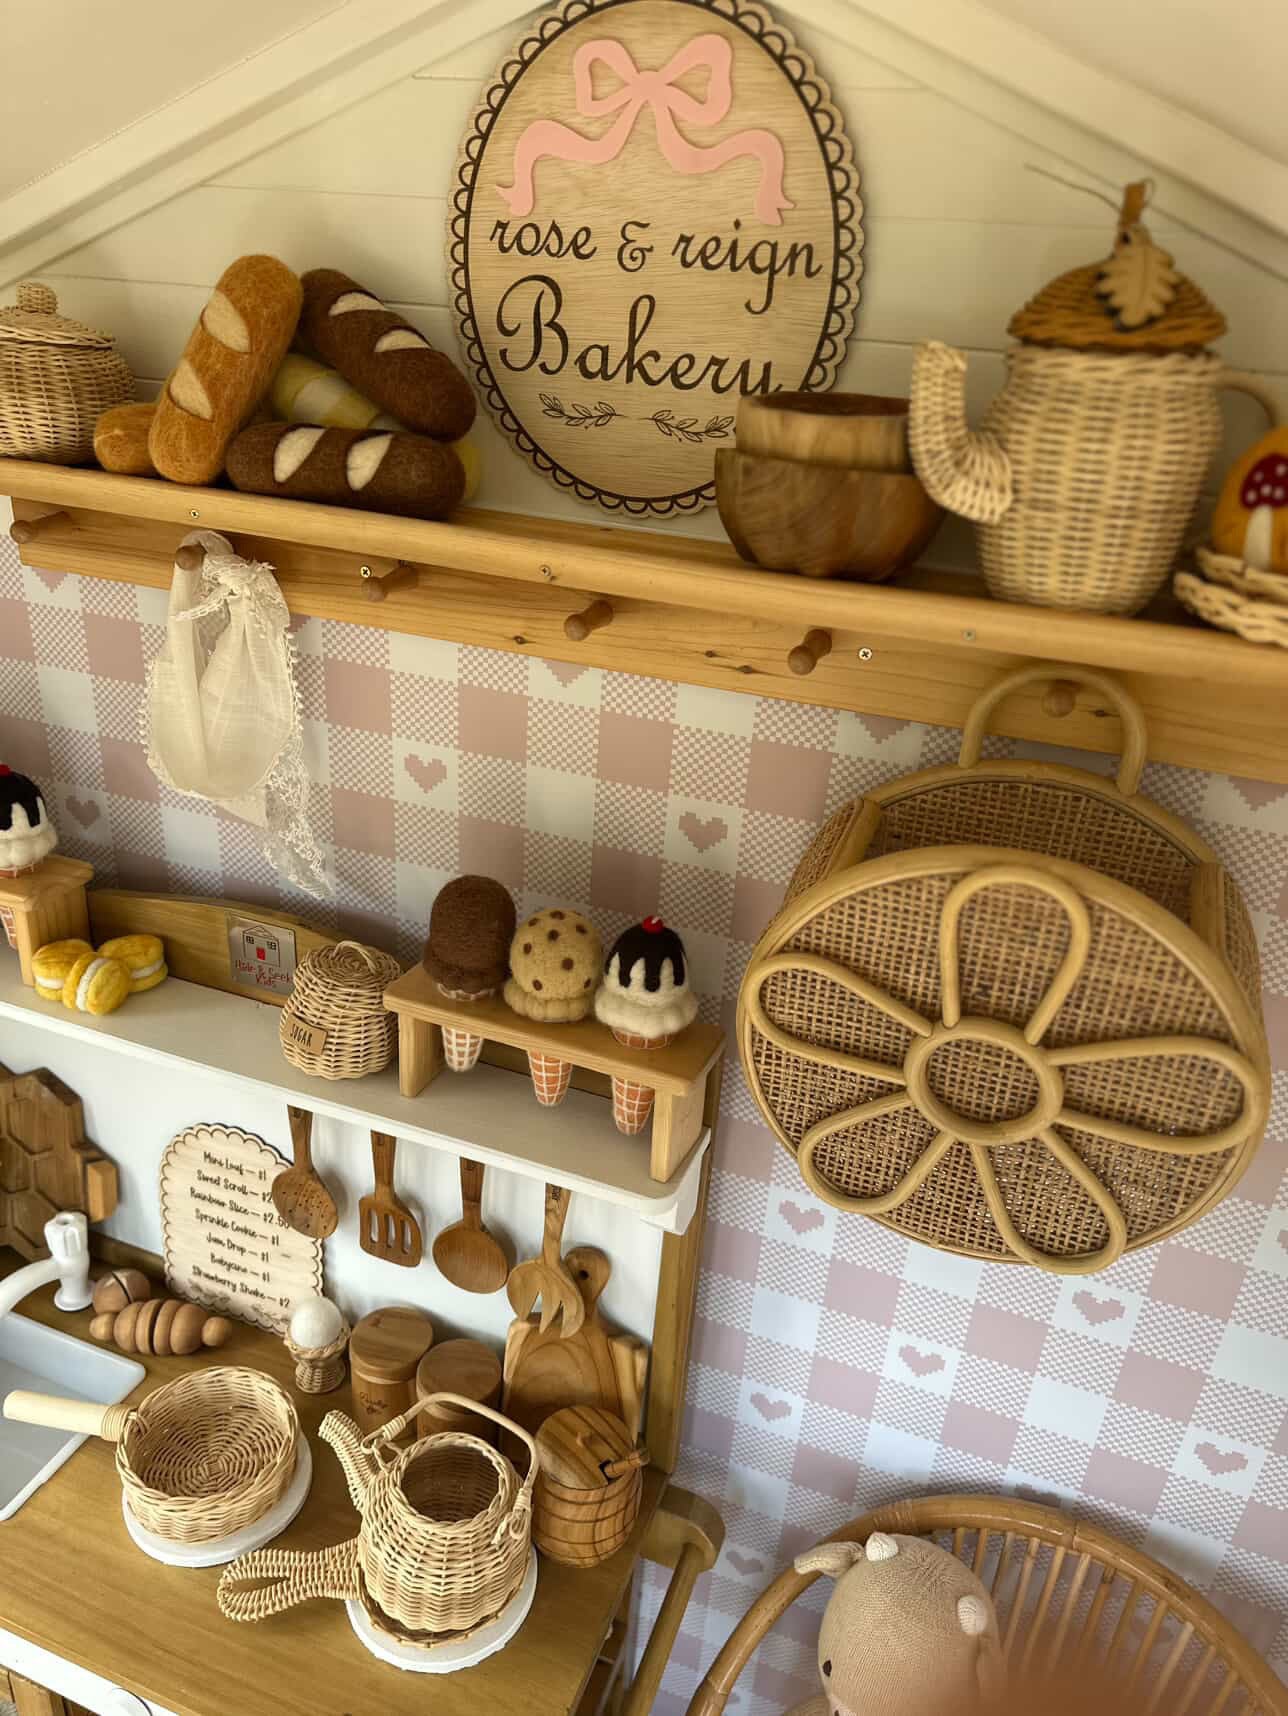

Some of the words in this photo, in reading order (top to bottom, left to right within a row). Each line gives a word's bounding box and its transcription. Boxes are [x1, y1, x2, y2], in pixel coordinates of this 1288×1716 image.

[489, 218, 598, 261] rose
[617, 220, 655, 273] &
[671, 218, 824, 316] reign
[289, 1023, 313, 1048] SUGAR
[203, 1151, 224, 1167] Mini
[225, 1157, 244, 1176] Loaf
[258, 1169, 267, 1181] $1
[190, 1186, 227, 1207] Rainbow
[228, 1199, 250, 1215] Slice
[223, 1177, 249, 1195] Scroll
[194, 1207, 230, 1229] Sprinkle
[231, 1220, 258, 1238] Cookie
[271, 1234, 280, 1246] $1
[206, 1231, 226, 1247] Jam
[226, 1237, 246, 1256] Drop
[261, 1251, 269, 1263] $1
[192, 1264, 237, 1293] Strawberry
[239, 1282, 265, 1299] Shake
[279, 1297, 291, 1308] $2
[262, 1271, 270, 1283] $1
